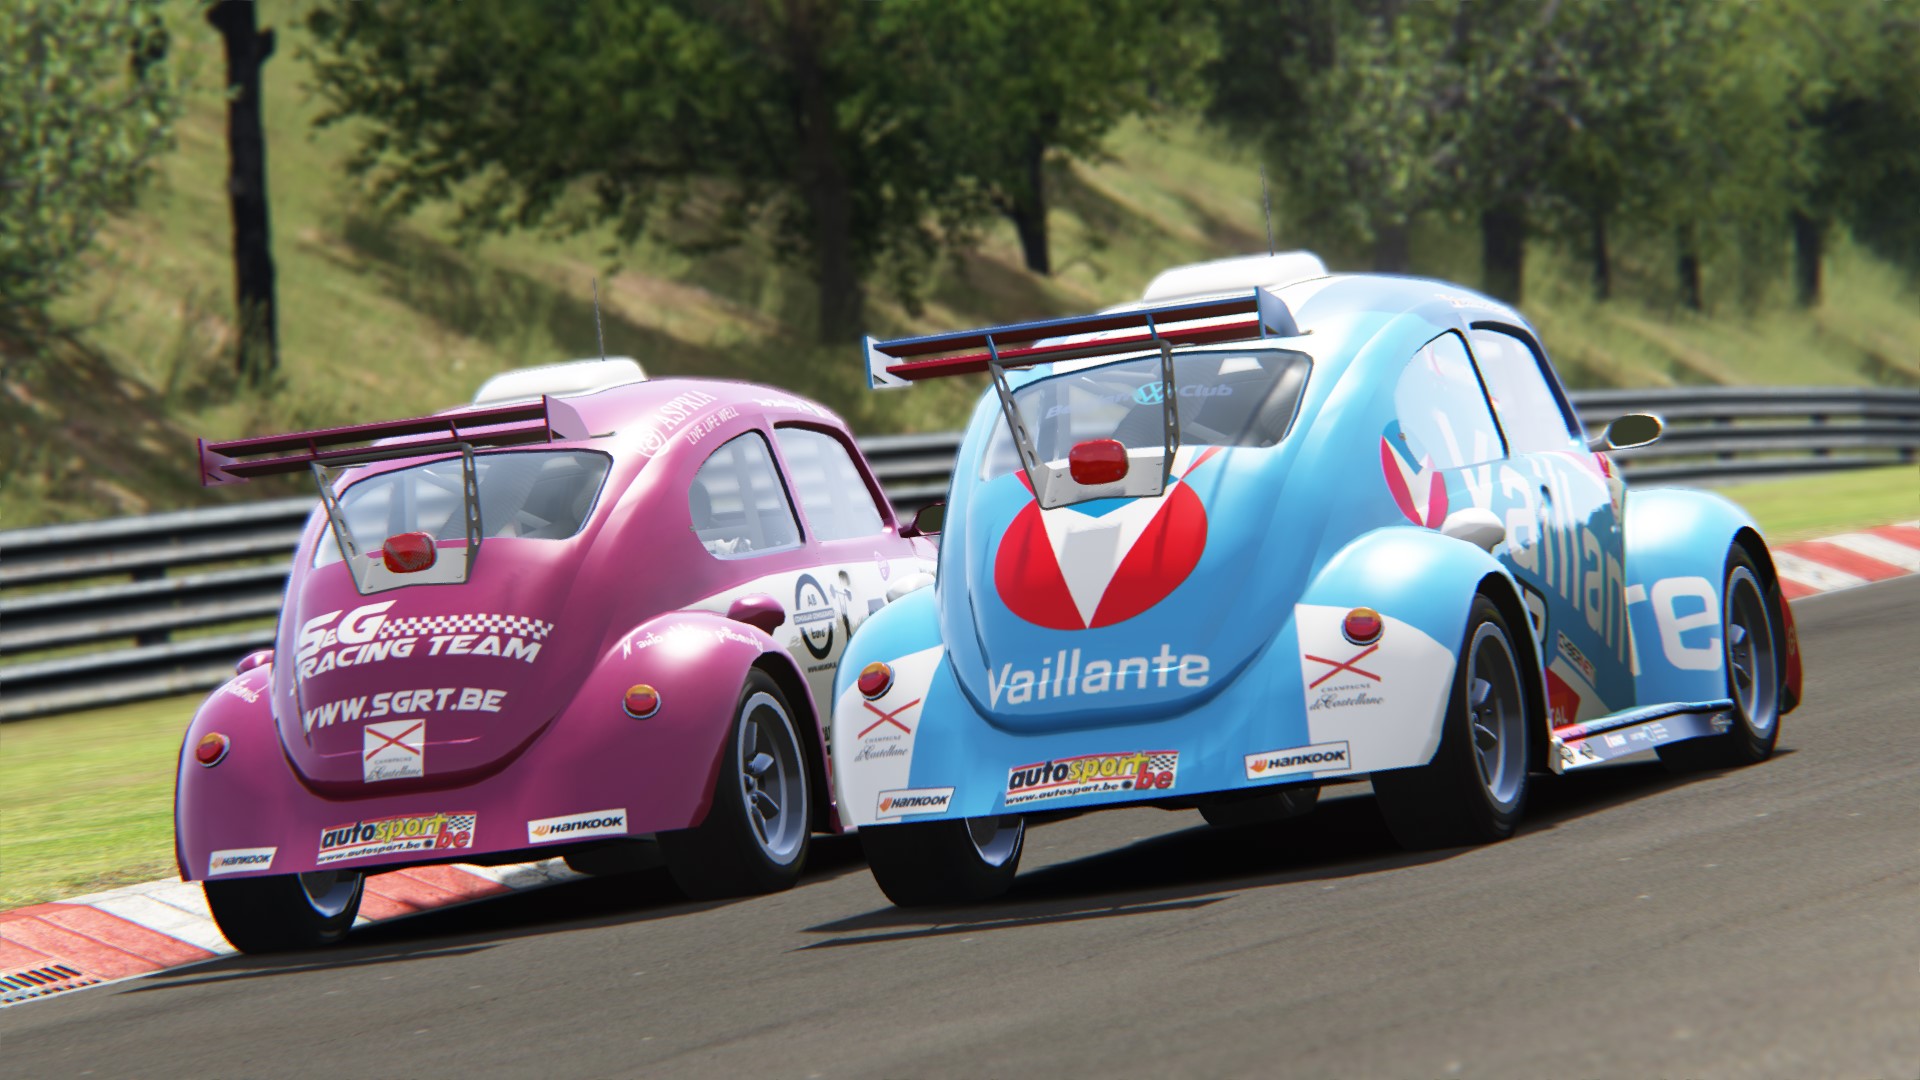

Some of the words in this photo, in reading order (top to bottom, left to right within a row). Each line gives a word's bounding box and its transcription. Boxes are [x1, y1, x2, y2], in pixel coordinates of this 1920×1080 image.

[654, 389, 718, 430] ASPRIA
[1179, 384, 1234, 397] Club
[685, 427, 706, 446] LIVE
[702, 416, 719, 434] LIFE
[718, 406, 740, 425] WELL
[297, 636, 419, 684] RACING
[428, 634, 542, 664] TEAM
[988, 644, 1210, 711] Vaillante
[1321, 682, 1371, 693] CHAMPAGNE
[1005, 782, 1119, 805] www.autosport.be
